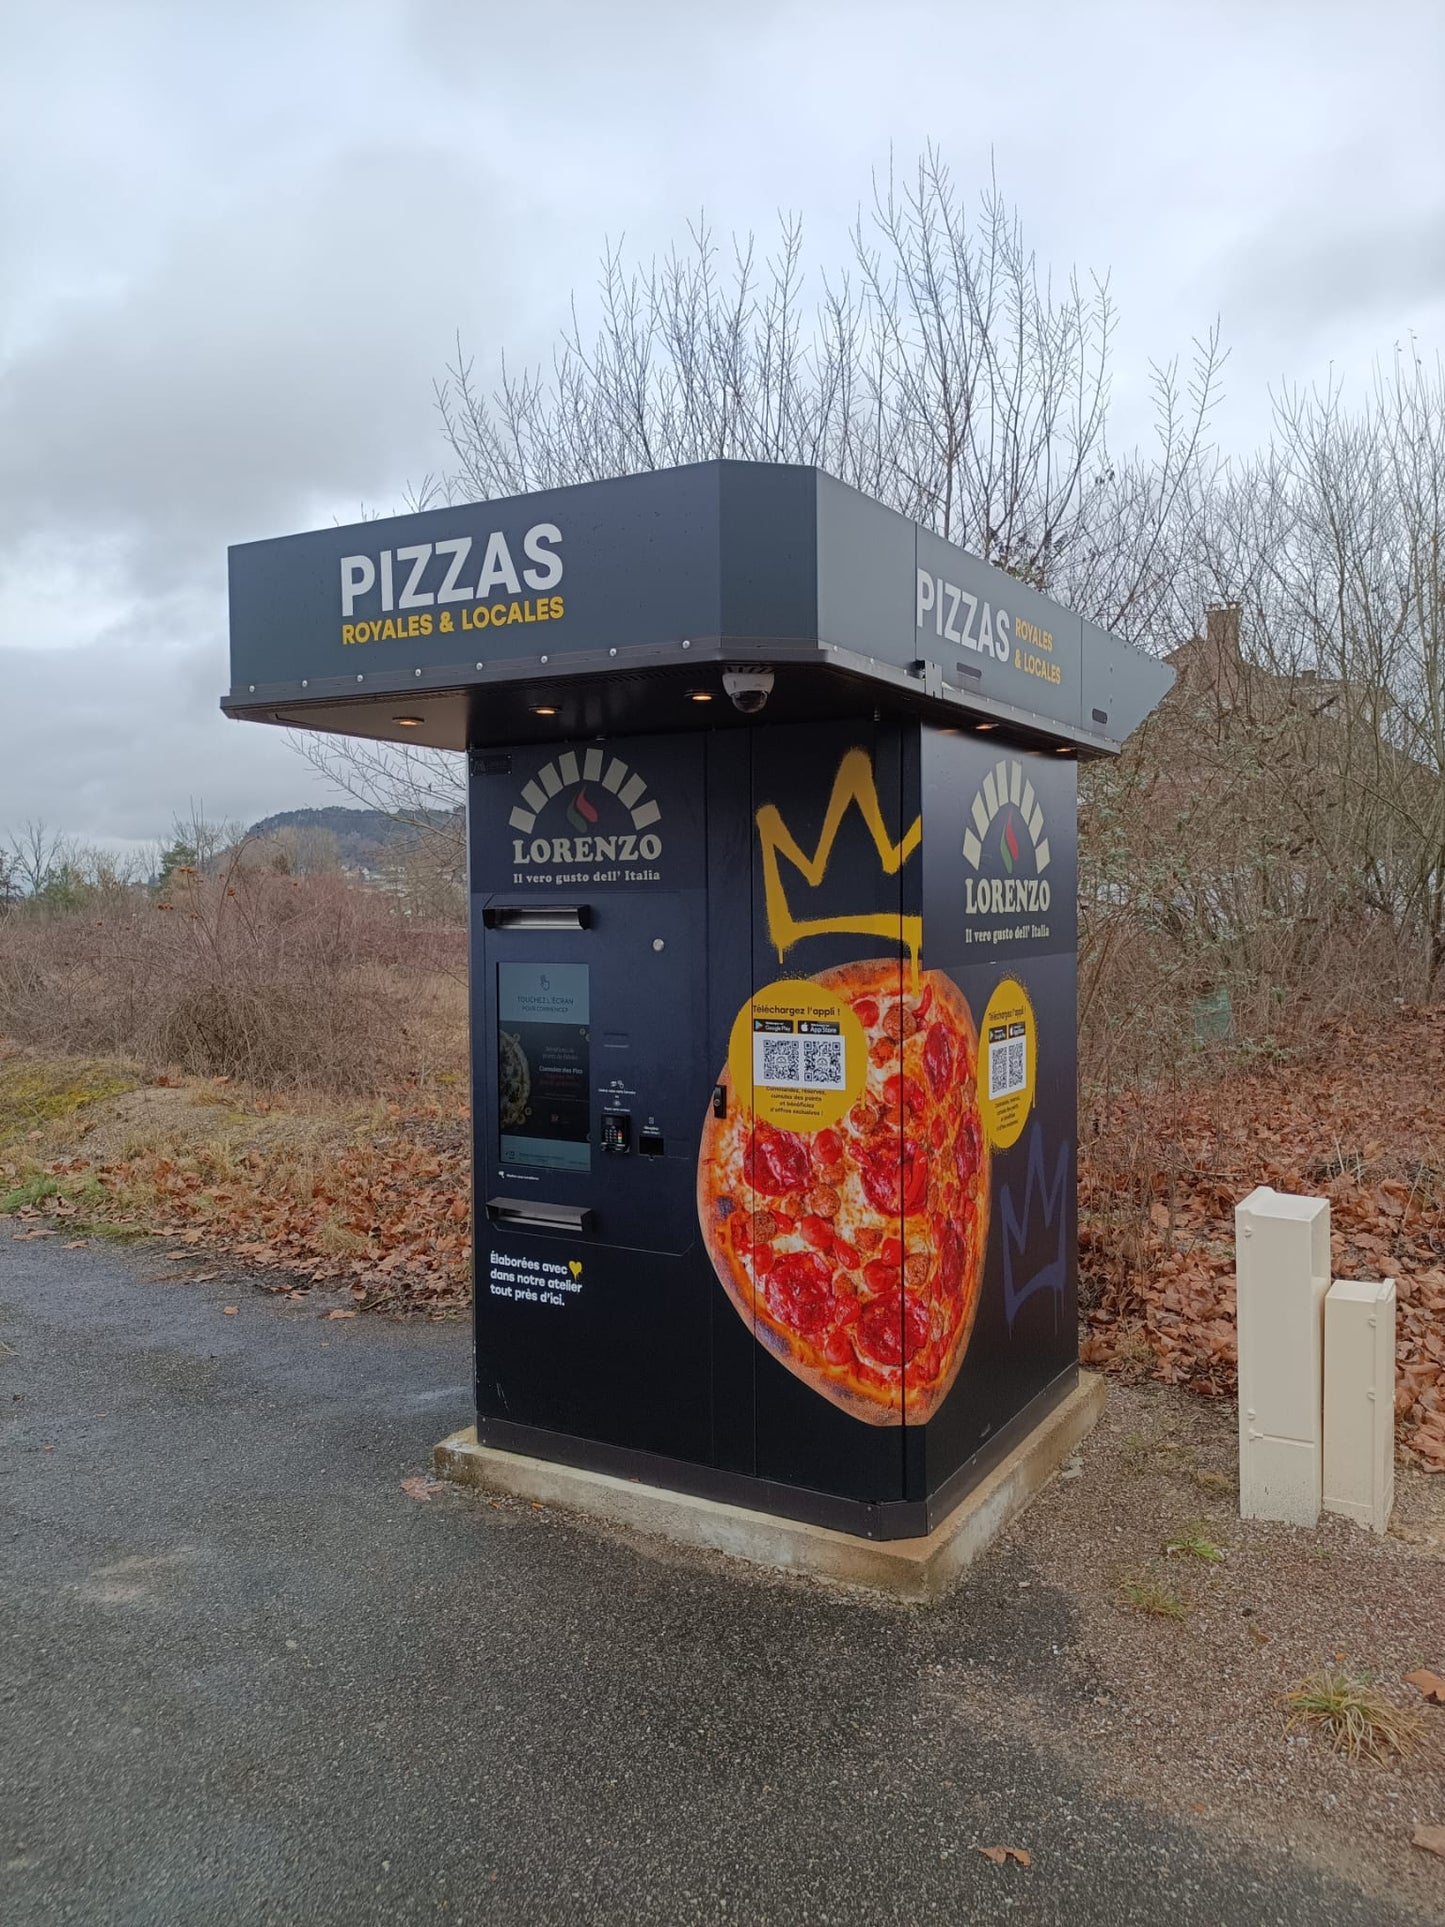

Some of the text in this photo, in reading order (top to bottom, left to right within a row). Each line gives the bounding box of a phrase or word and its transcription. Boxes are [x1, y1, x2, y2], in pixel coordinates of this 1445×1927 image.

[340, 523, 564, 617] PIZZAS
[342, 596, 565, 646] ROYALES & LOCALES
[916, 567, 1010, 663] PIZZAS
[1015, 616, 1054, 652] ROYALES
[1014, 650, 1062, 686] & LOCALES
[512, 833, 662, 864] LORENZO
[513, 869, 661, 885] Il vero gusto dell' Italia
[965, 877, 1051, 914] LORENZO
[965, 928, 972, 944] Il
[973, 929, 992, 943] vero
[992, 927, 1013, 945] gusto
[1031, 923, 1050, 938] Italia
[752, 1005, 805, 1017] Téléchargez
[807, 1007, 835, 1018] l'appli
[764, 1024, 781, 1033] Google
[810, 1026, 822, 1034] App
[489, 1250, 568, 1276] Élaborées avec
[489, 1268, 582, 1294] dans notre atelier
[489, 1283, 566, 1306] tout près d'ici.
